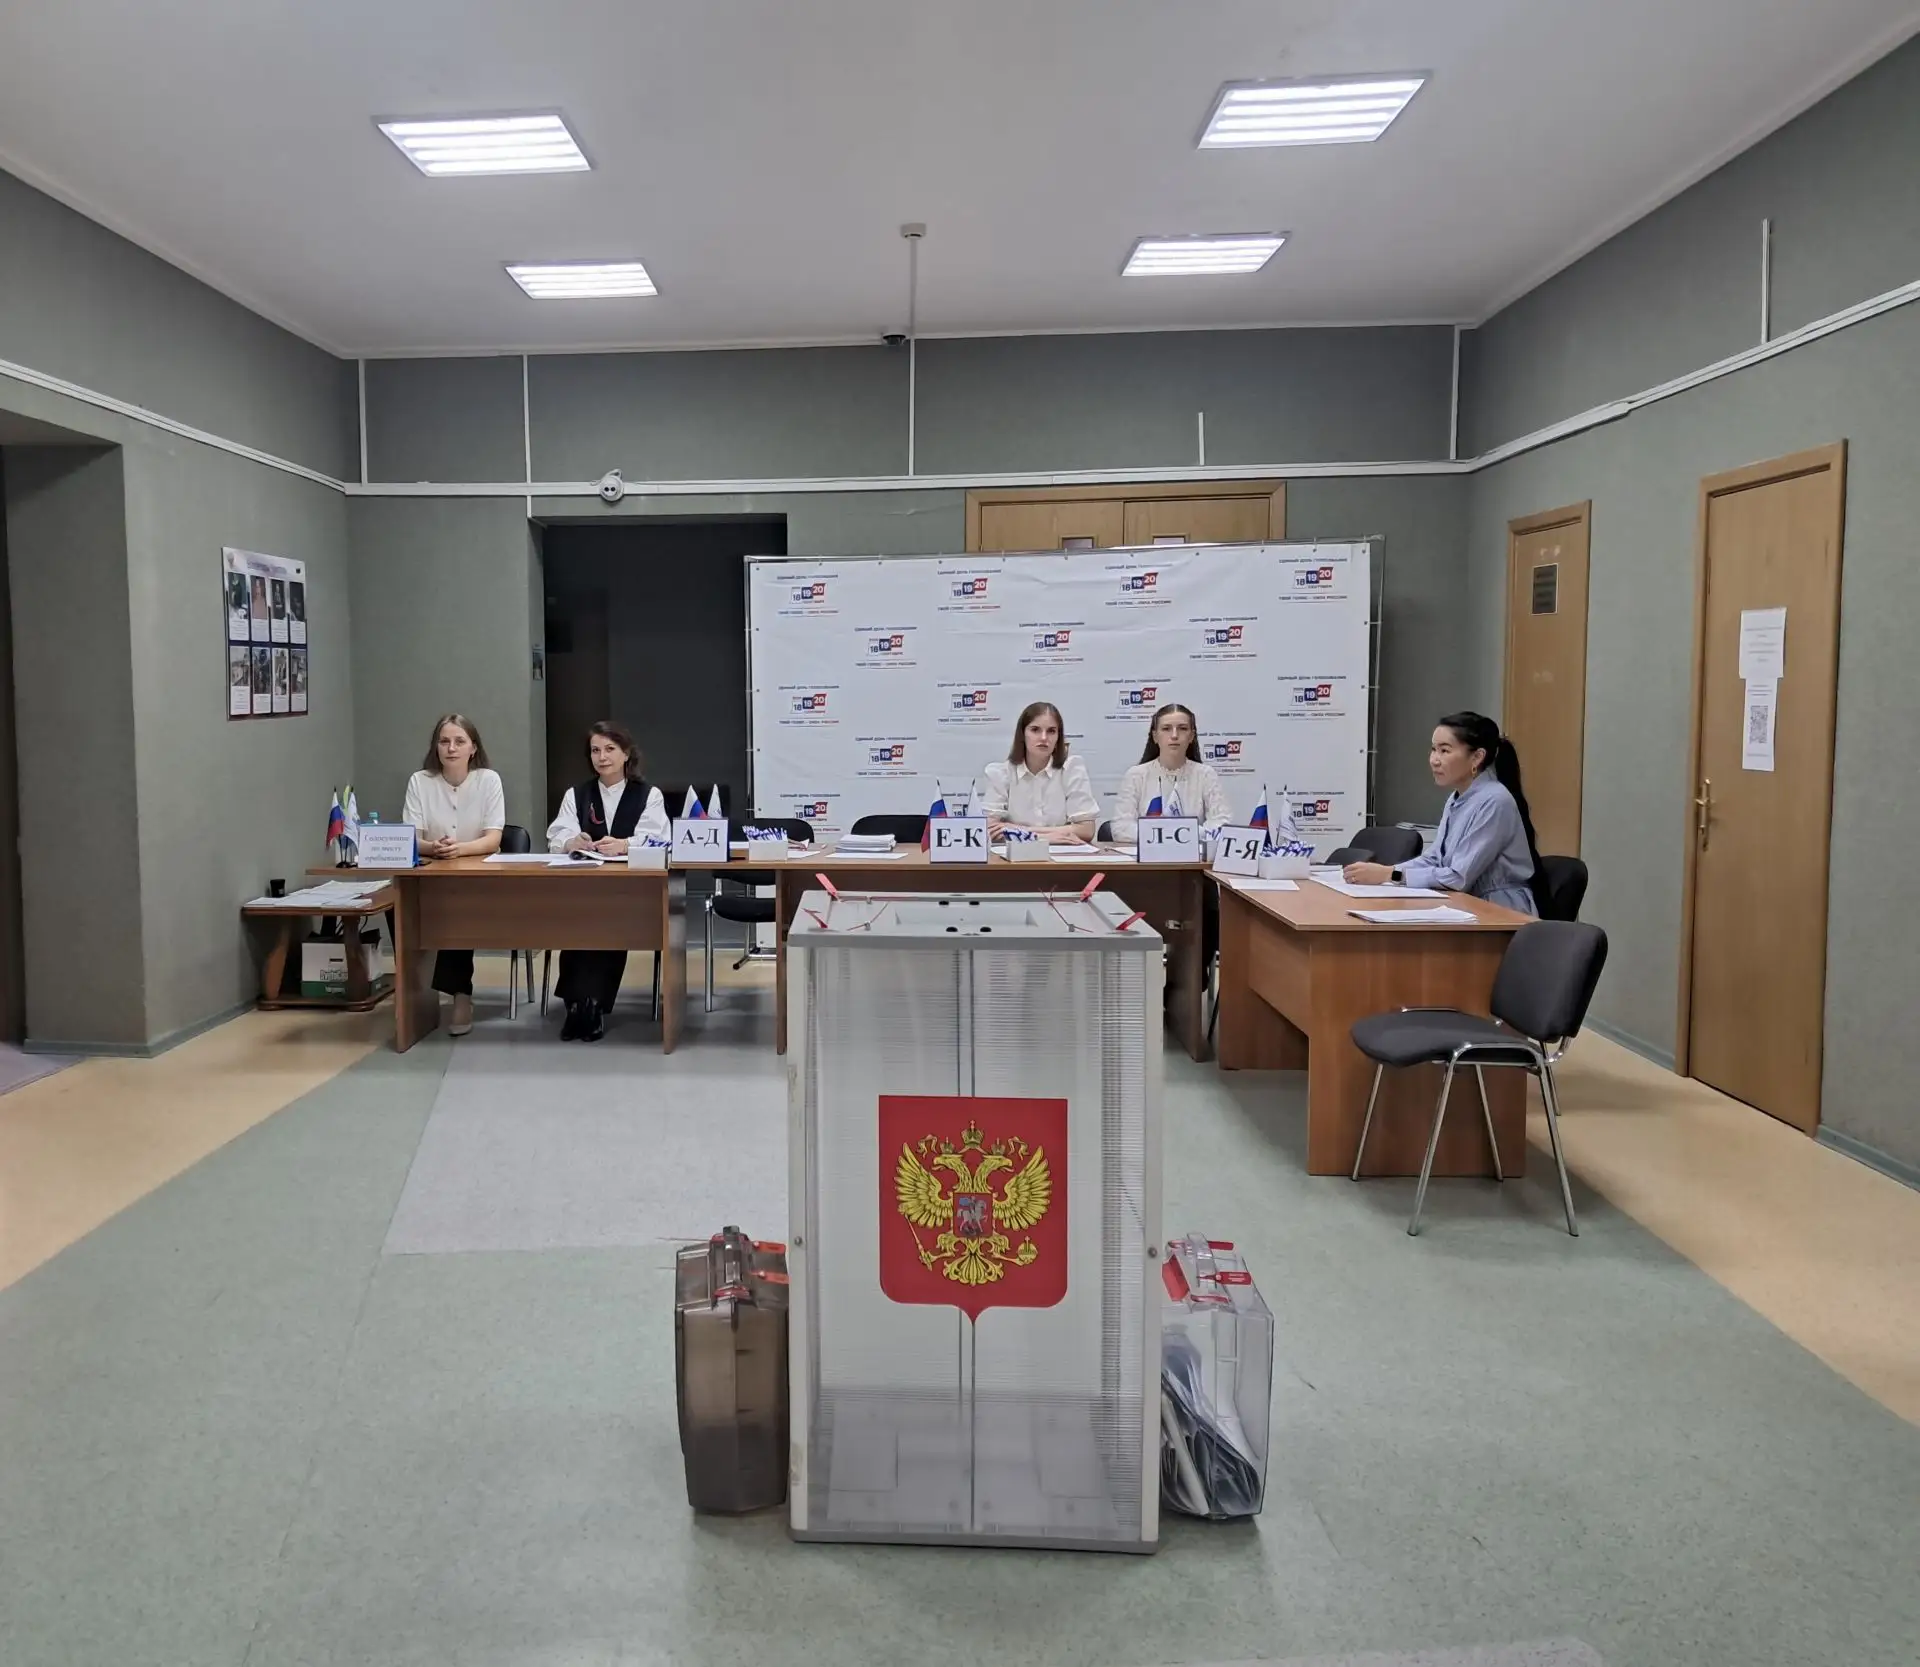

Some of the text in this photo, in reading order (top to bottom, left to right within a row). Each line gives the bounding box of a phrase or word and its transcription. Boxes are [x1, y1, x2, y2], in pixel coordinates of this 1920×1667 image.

[681, 828, 720, 848] А-Д
[936, 828, 983, 848] Е-К
[1147, 827, 1191, 844] Л-С
[1222, 837, 1260, 860] Т-Я
